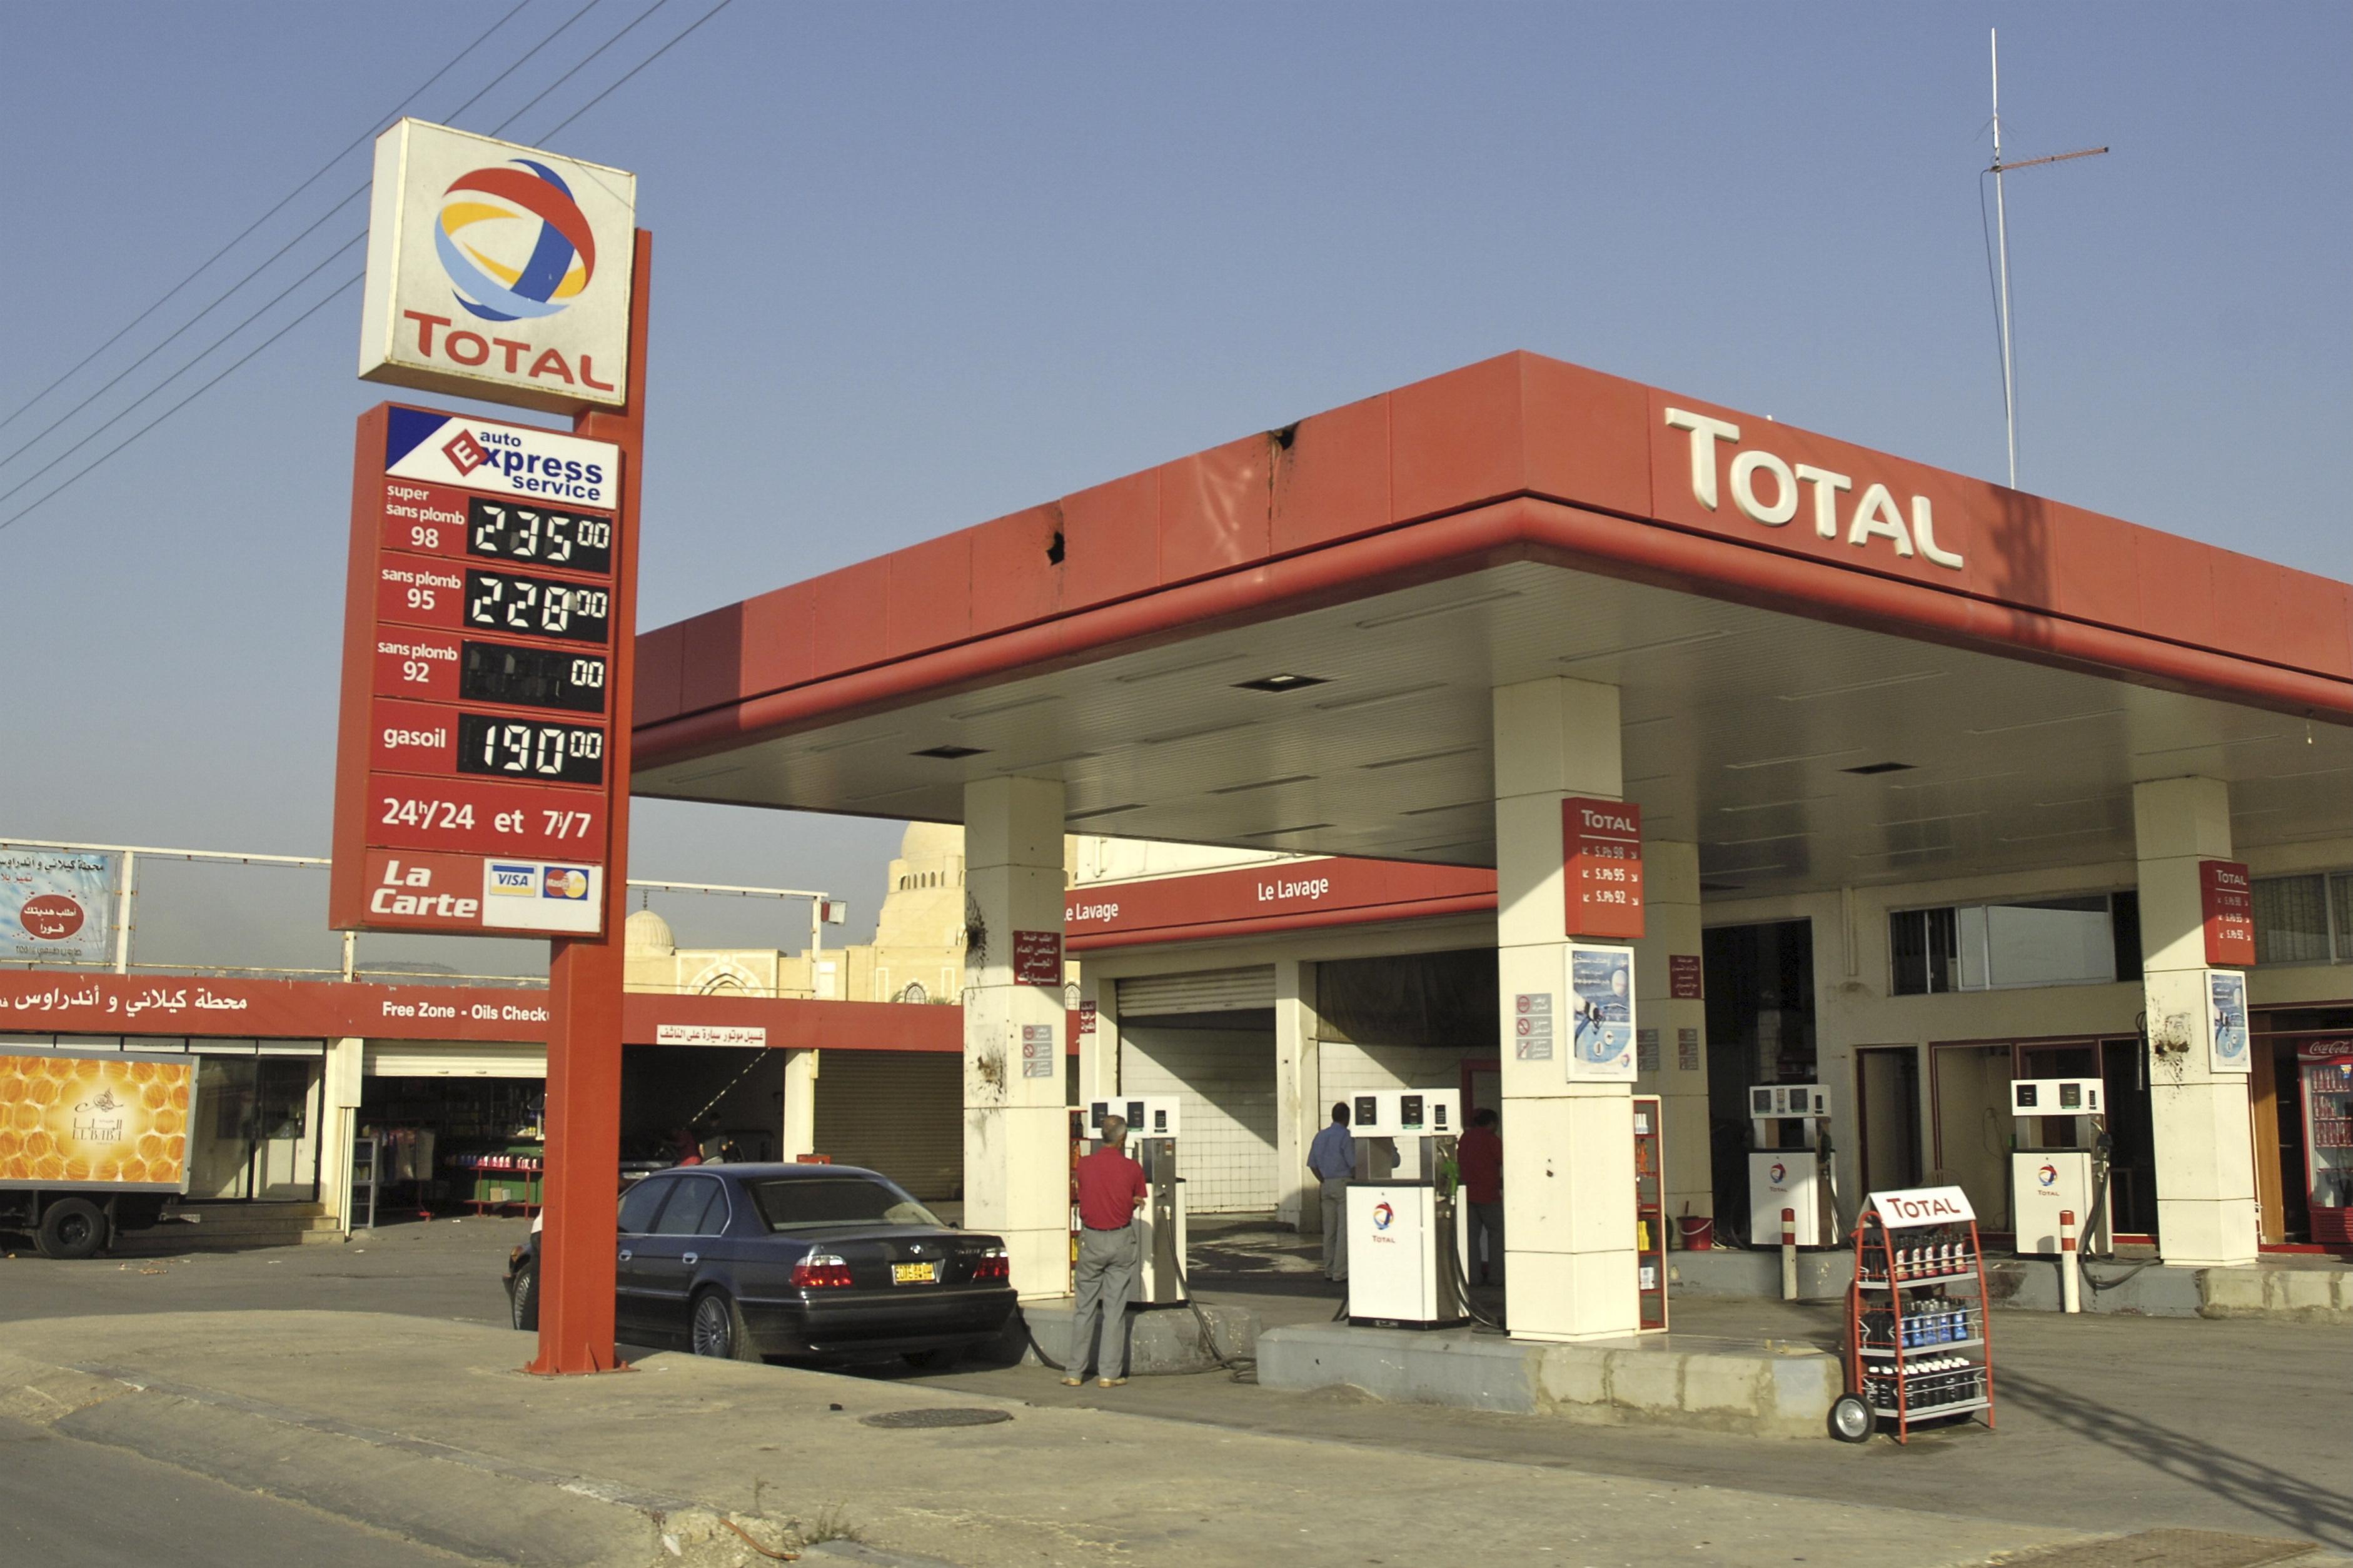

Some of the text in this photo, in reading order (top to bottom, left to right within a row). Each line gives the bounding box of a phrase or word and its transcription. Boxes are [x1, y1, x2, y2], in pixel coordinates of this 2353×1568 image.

[480, 430, 521, 448] auto
[387, 485, 429, 501] super
[512, 475, 601, 501] service
[386, 503, 465, 526] sans plomb
[410, 526, 439, 548] 98
[475, 505, 572, 561] 235
[381, 568, 461, 590] sans plomb
[406, 588, 435, 610] 95
[472, 577, 569, 632] 228
[377, 641, 458, 663] sans plomb
[402, 660, 430, 683] 92
[570, 659, 605, 688] 00
[383, 726, 446, 751] gasoil
[484, 725, 565, 774] 190
[494, 809, 524, 834] et
[383, 860, 431, 888] La
[497, 873, 528, 887] VISA
[1258, 877, 1329, 902] Le Lavage
[370, 888, 478, 918] Carte
[1064, 902, 1119, 922] e Lavage
[14, 984, 99, 1011] أندراوس
[106, 995, 118, 1013] و
[126, 989, 187, 1017] كيلاني
[195, 987, 248, 1011] محطة
[382, 1002, 415, 1018] Free
[418, 1003, 455, 1018] Zone
[471, 1004, 498, 1020] Oils
